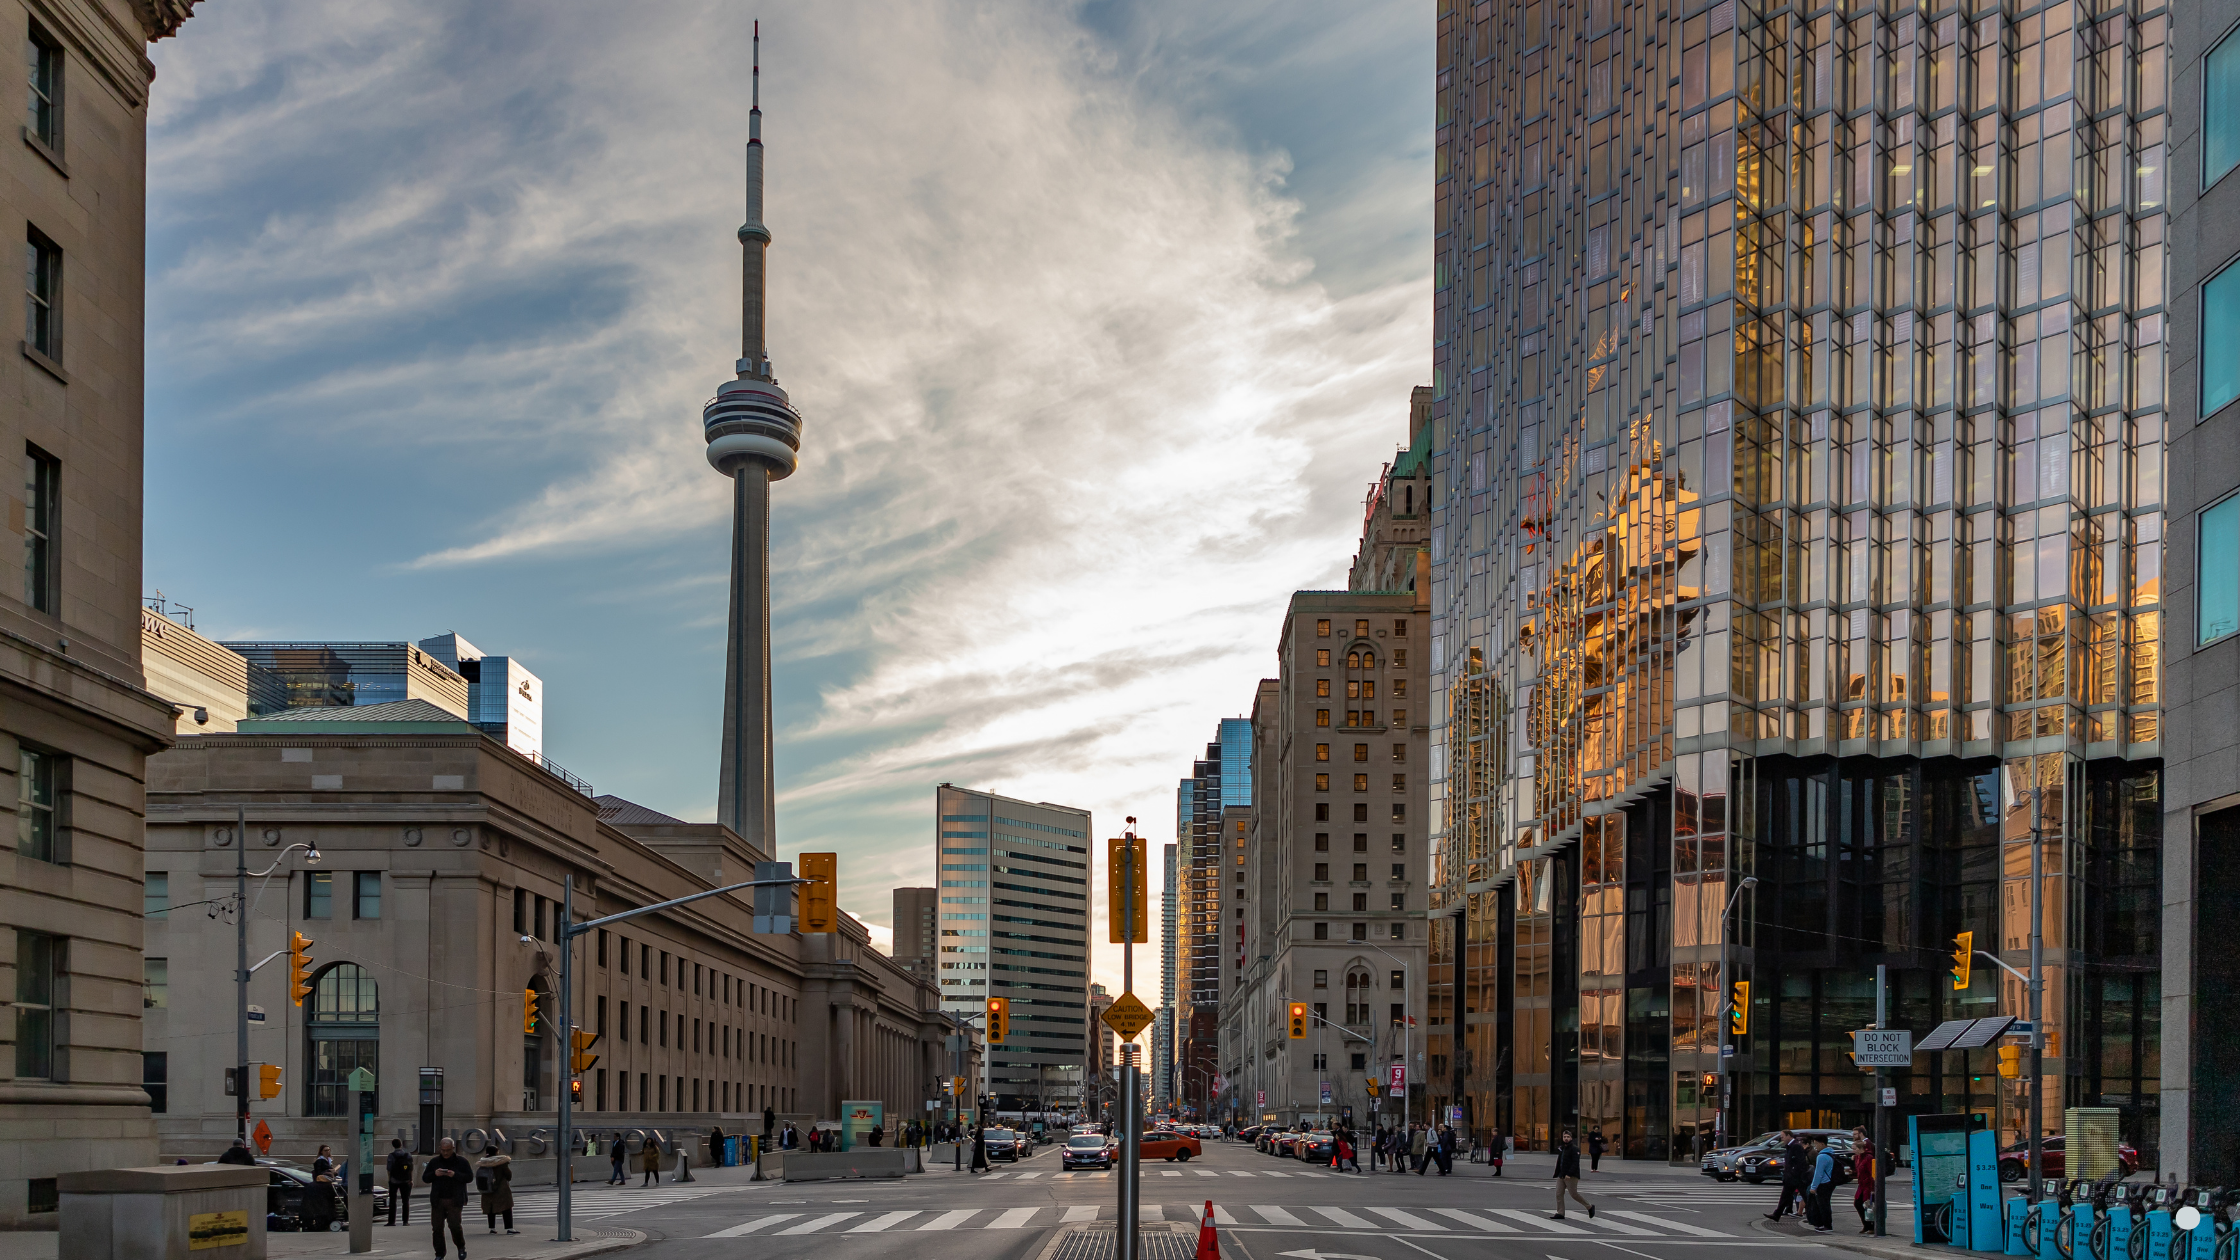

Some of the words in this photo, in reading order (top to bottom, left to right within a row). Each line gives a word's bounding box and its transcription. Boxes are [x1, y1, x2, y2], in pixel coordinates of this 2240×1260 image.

[1112, 1005, 1144, 1013] CAUTION
[1864, 1033, 1878, 1042] DO
[1882, 1033, 1902, 1042] NOT
[1867, 1043, 1900, 1052] BLOCK
[1857, 1053, 1910, 1063] INTERSECTION
[1395, 1068, 1401, 1079] 9
[398, 1128, 516, 1155] UION
